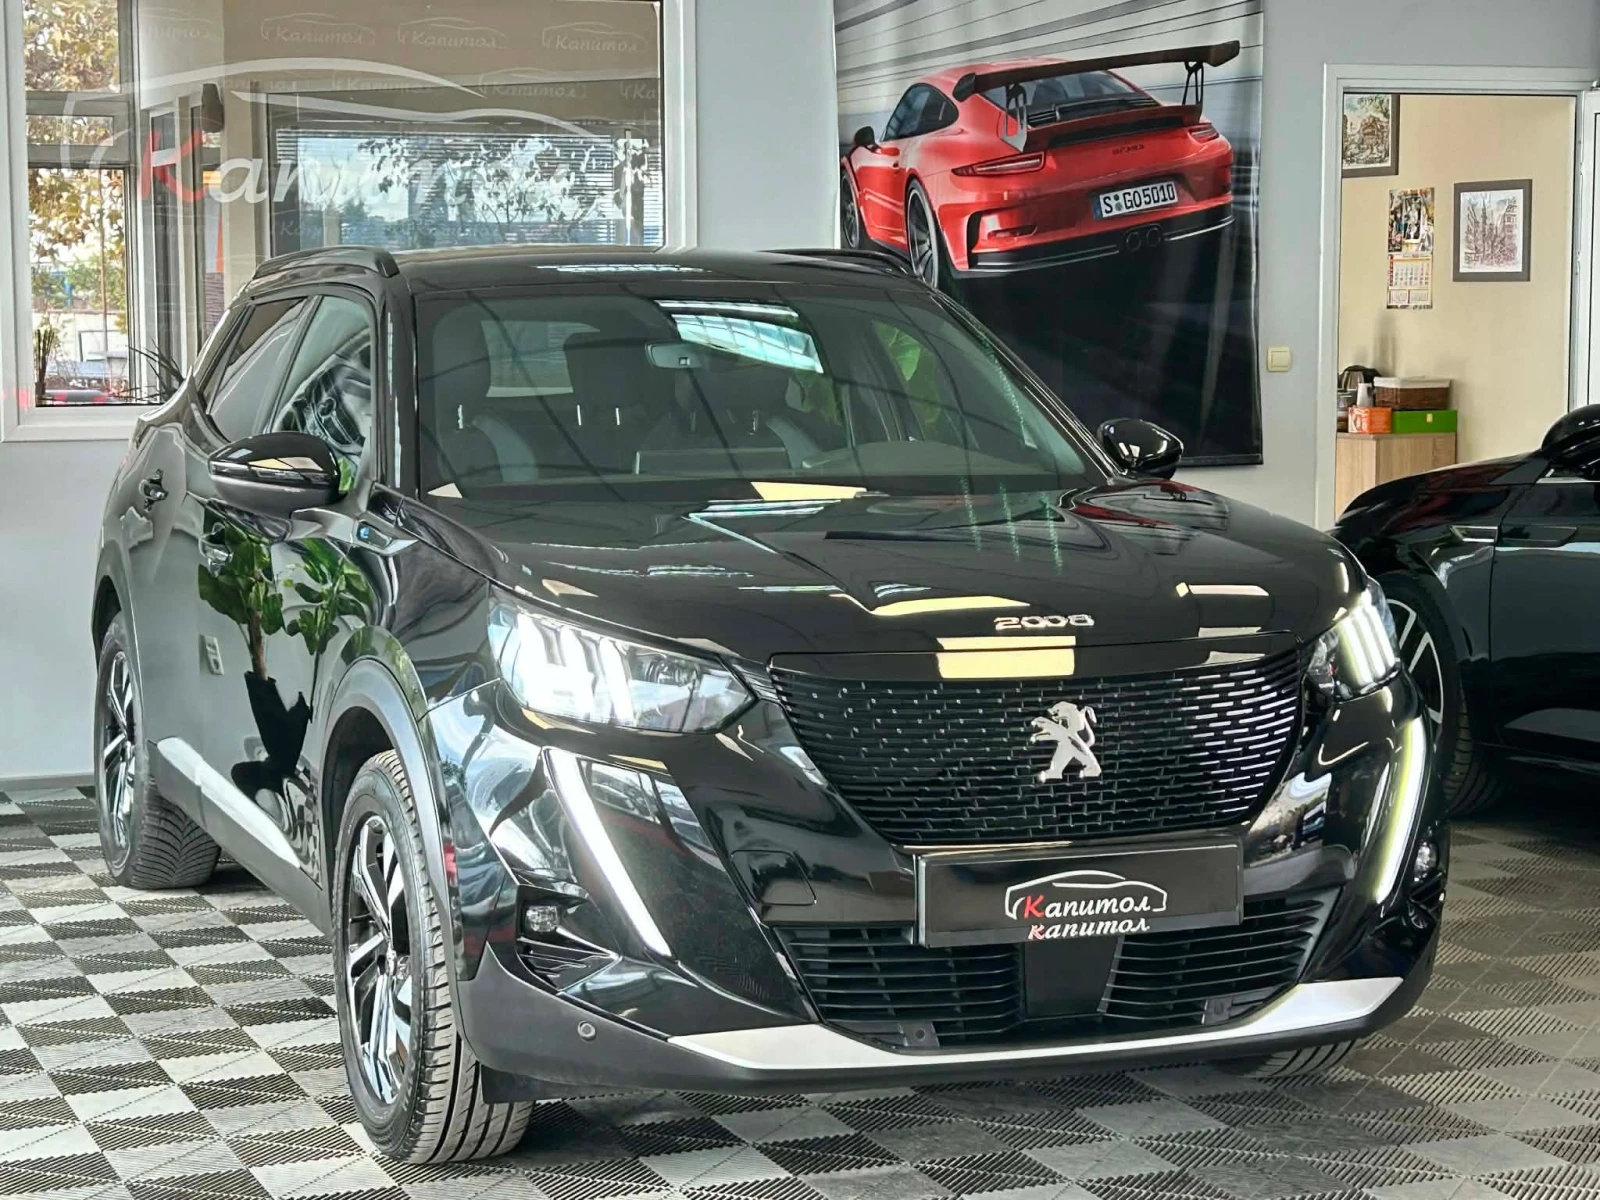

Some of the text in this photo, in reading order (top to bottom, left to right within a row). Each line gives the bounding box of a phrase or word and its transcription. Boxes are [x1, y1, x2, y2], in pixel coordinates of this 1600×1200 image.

[275, 25, 364, 45] Капитол
[411, 31, 497, 48] Капитол
[555, 35, 638, 51] Капитол
[1102, 195, 1114, 214] S
[993, 614, 1095, 631] 2008
[1023, 893, 1151, 919] Капитол
